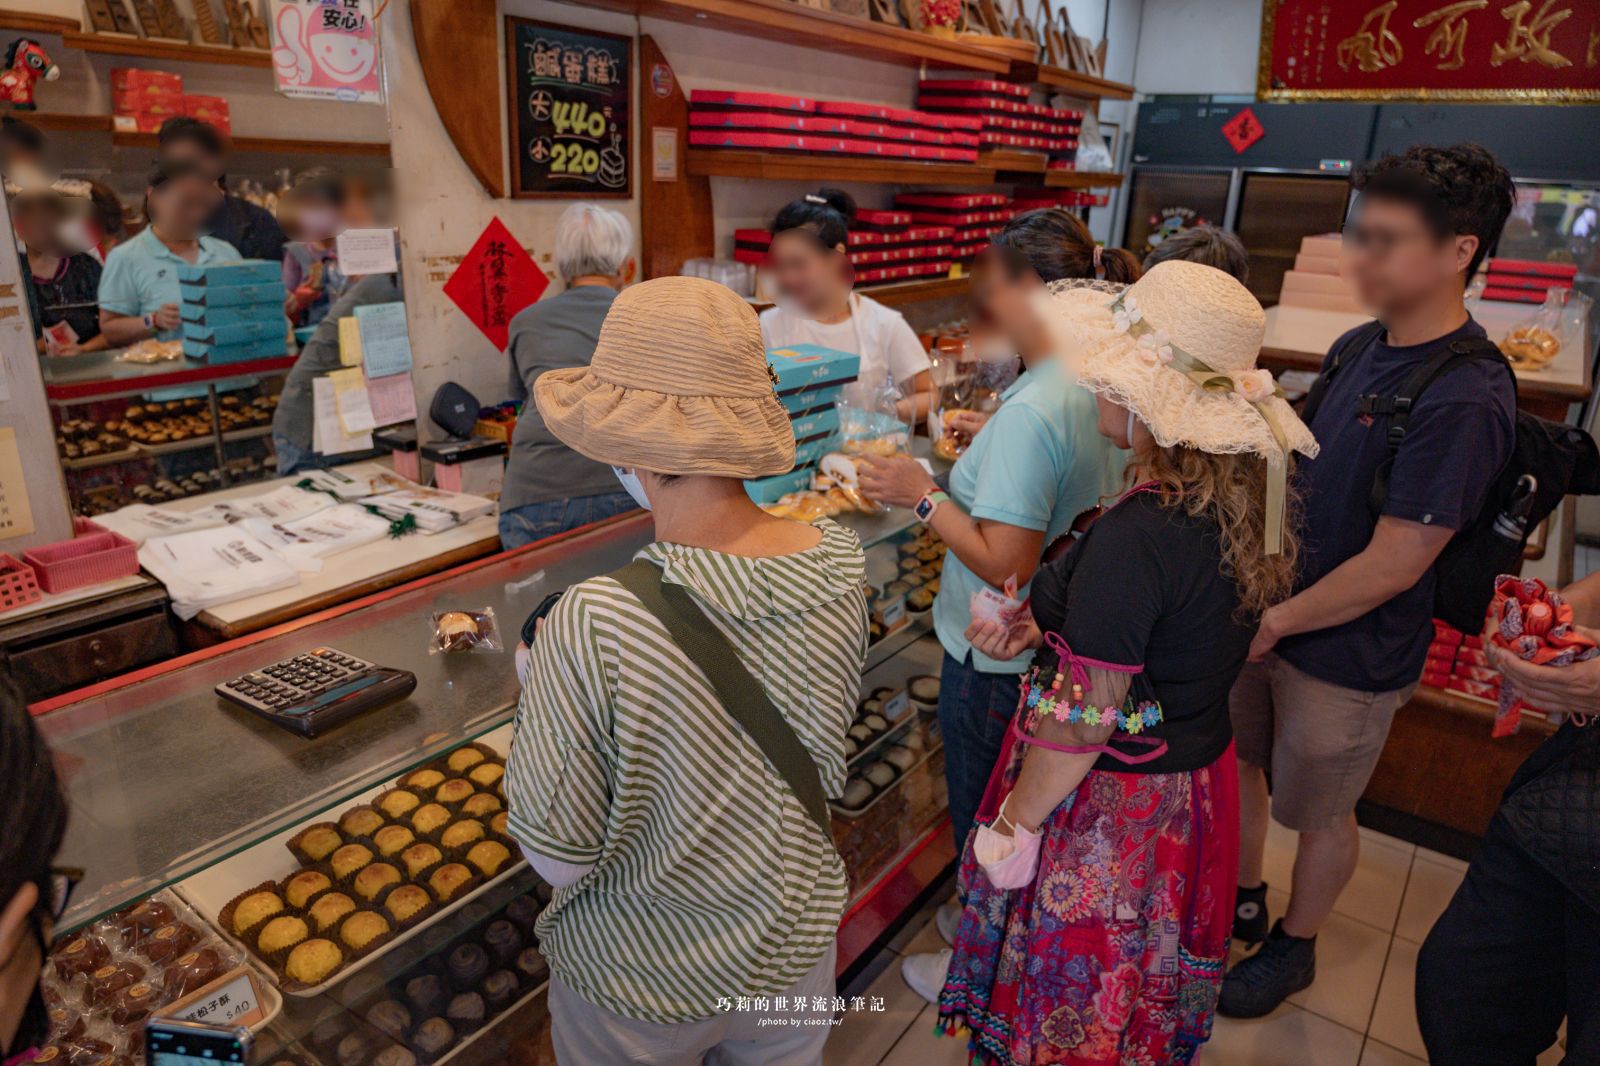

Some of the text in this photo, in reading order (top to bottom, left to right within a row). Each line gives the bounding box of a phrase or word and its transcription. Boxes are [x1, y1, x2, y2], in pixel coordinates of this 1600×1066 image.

[323, 9, 365, 30] 安心!
[532, 92, 551, 118] 大
[552, 100, 606, 137] 440
[531, 140, 599, 174] 小 220
